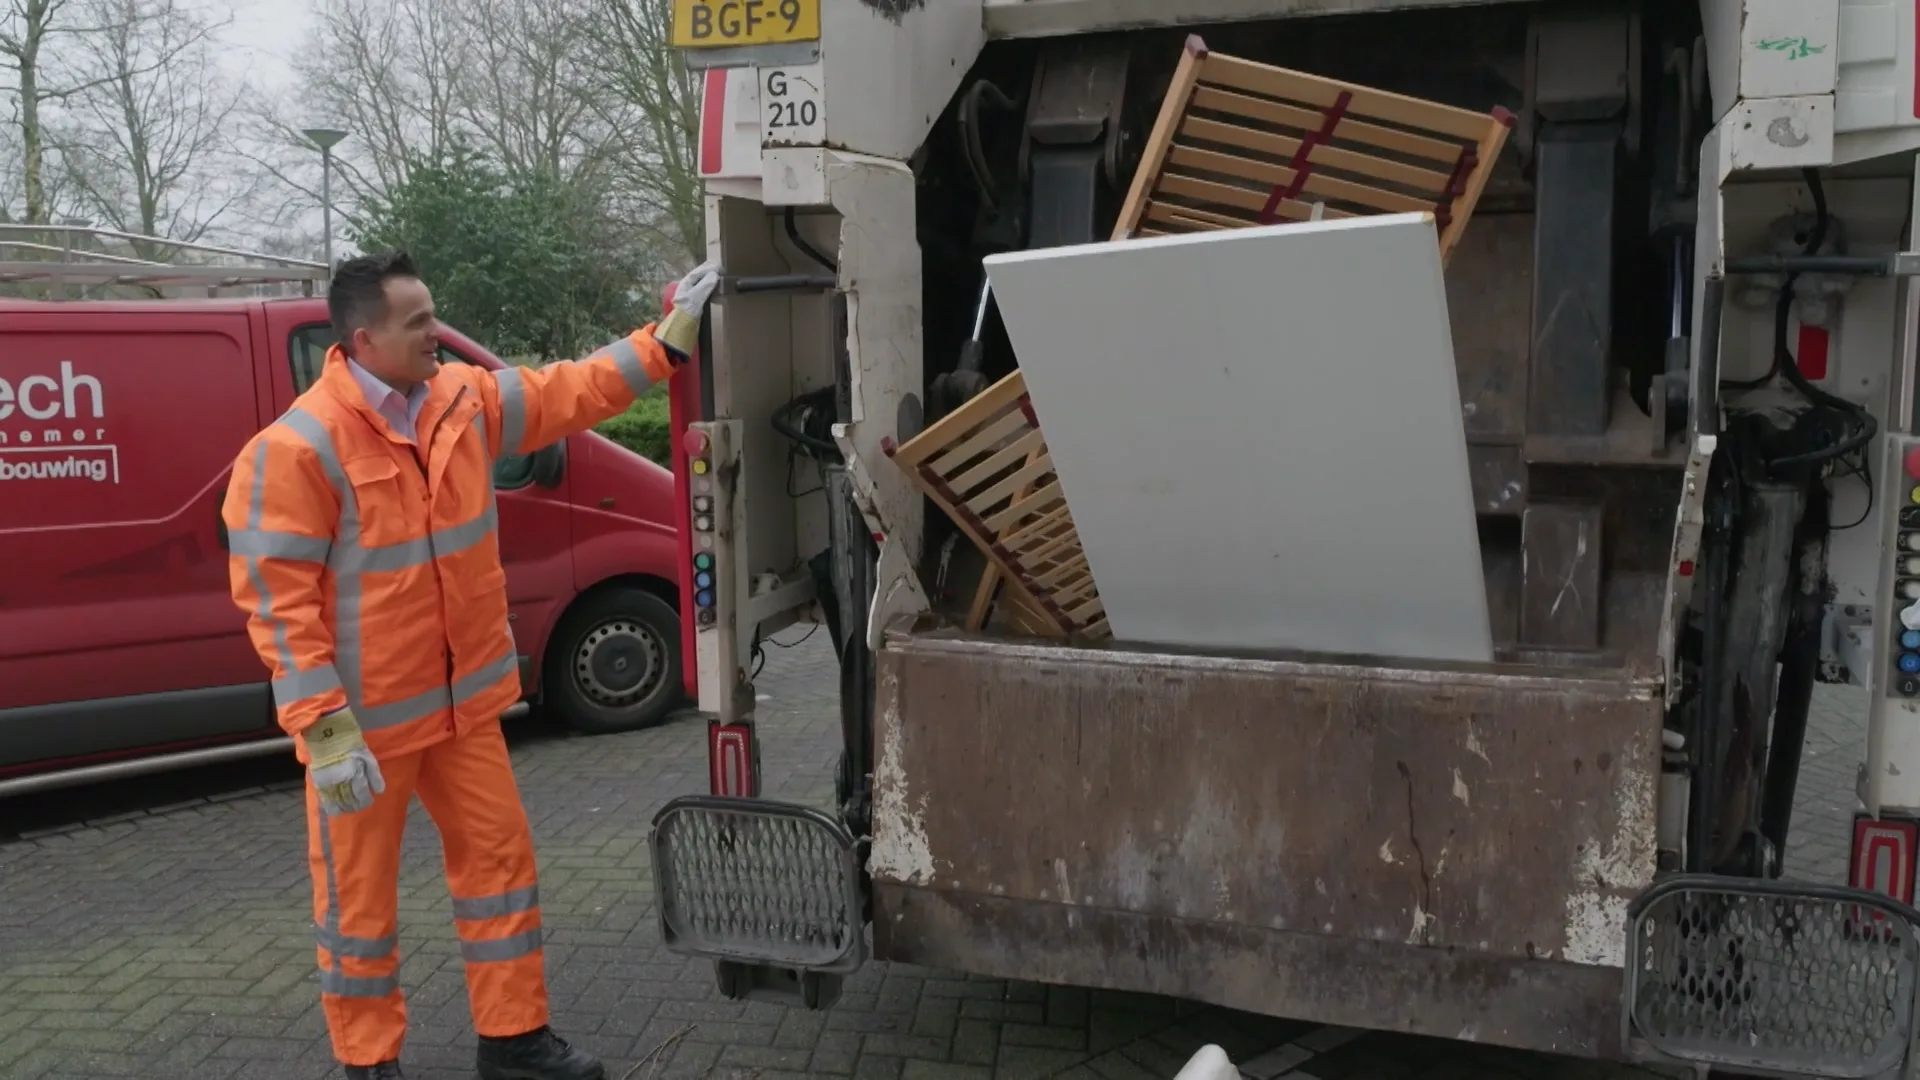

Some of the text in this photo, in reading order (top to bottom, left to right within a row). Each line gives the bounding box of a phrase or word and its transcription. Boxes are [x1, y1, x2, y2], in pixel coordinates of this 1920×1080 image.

[691, 0, 800, 39] BGF-9
[767, 71, 788, 97] G
[768, 100, 817, 128] 210
